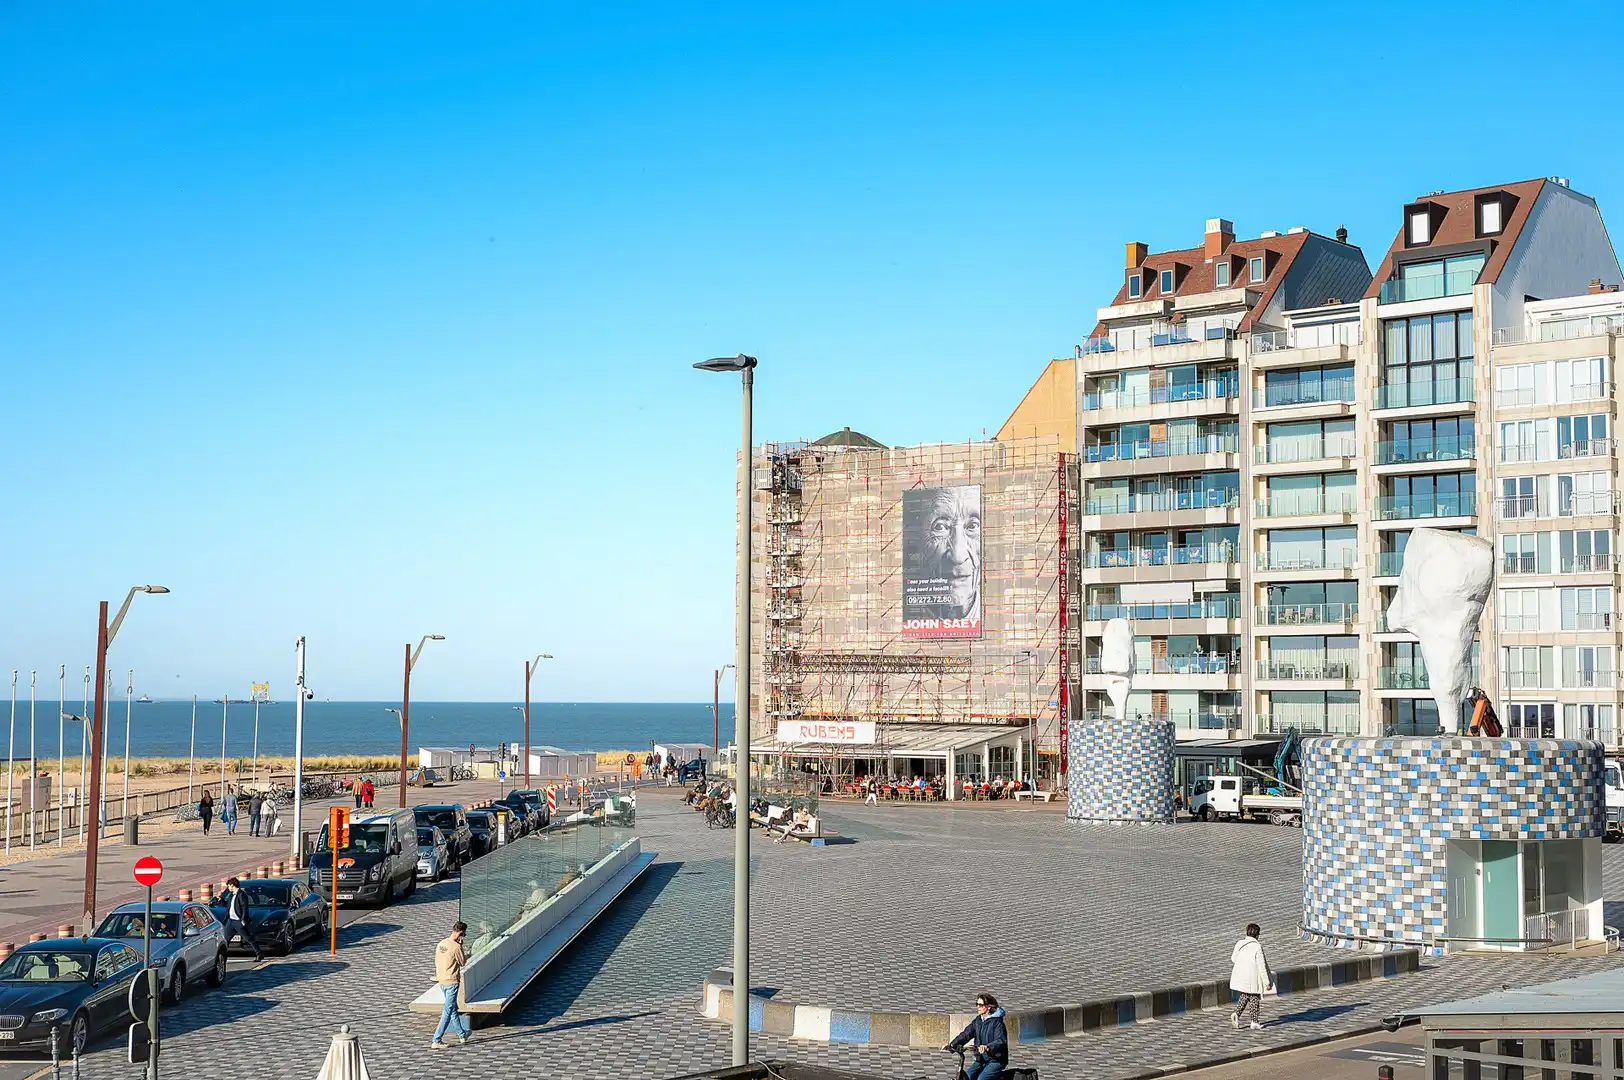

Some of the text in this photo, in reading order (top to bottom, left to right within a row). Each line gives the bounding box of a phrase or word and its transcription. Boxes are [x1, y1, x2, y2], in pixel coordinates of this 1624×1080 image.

[904, 619, 978, 630] JOHN SAEY
[800, 725, 855, 739] RUBENS
